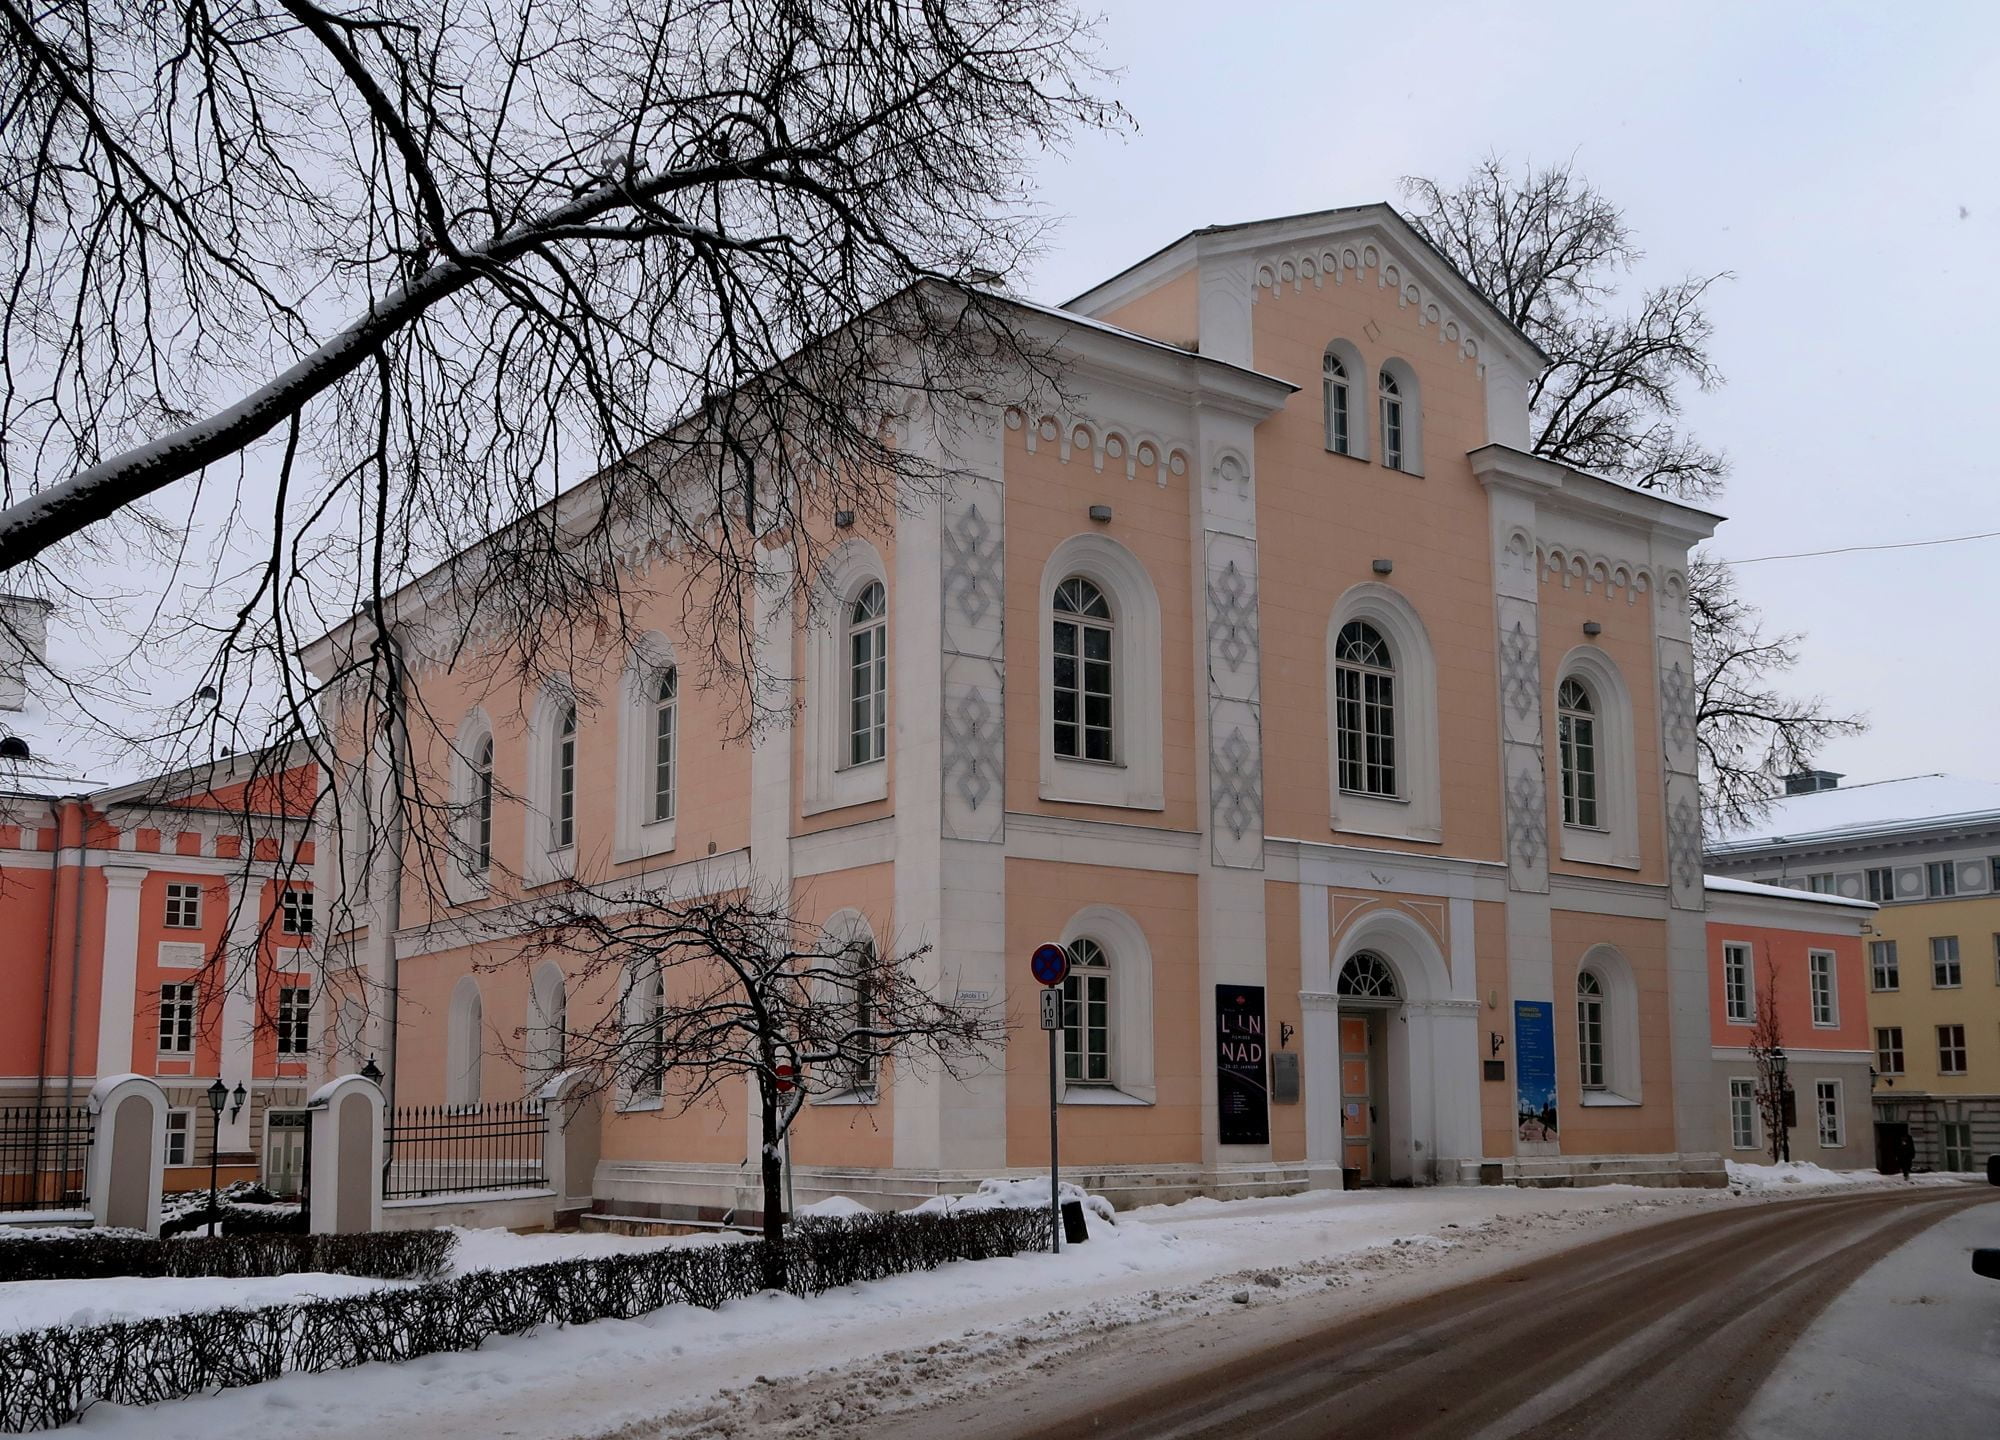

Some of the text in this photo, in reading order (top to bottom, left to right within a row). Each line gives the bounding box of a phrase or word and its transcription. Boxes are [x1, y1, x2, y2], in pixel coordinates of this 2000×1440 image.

[1043, 1008, 1054, 1018] 10
[1045, 1019, 1053, 1027] m
[1222, 1014, 1261, 1034] LIN
[1222, 1042, 1262, 1062] NAD
